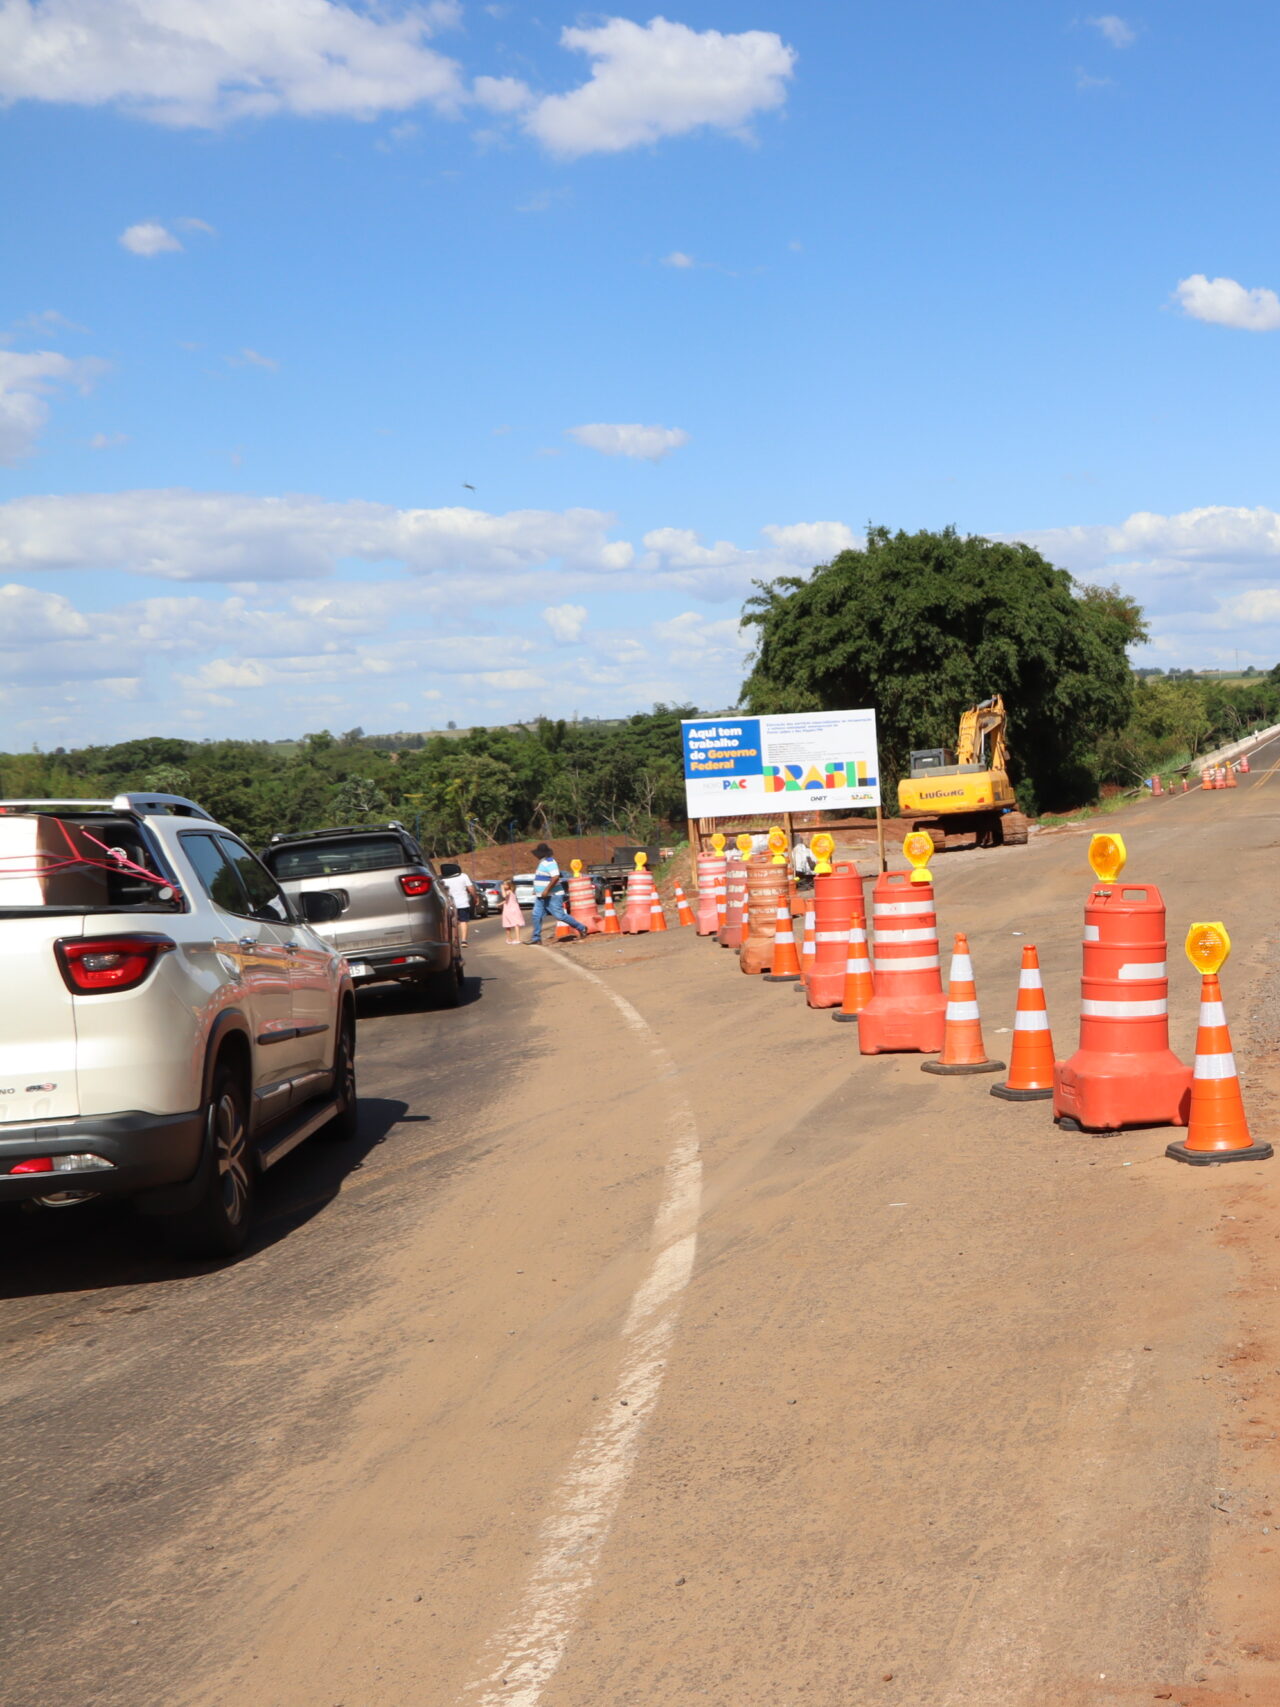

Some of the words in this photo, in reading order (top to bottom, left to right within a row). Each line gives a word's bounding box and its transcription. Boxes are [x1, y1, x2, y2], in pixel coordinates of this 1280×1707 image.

[688, 727, 717, 739] Aqui
[718, 727, 743, 737] tem
[688, 738, 739, 749] trabalho
[690, 750, 706, 760] do
[708, 749, 757, 759] Governo
[690, 759, 735, 771] Federal
[763, 761, 877, 792] BRASIL
[723, 779, 747, 790] PAC
